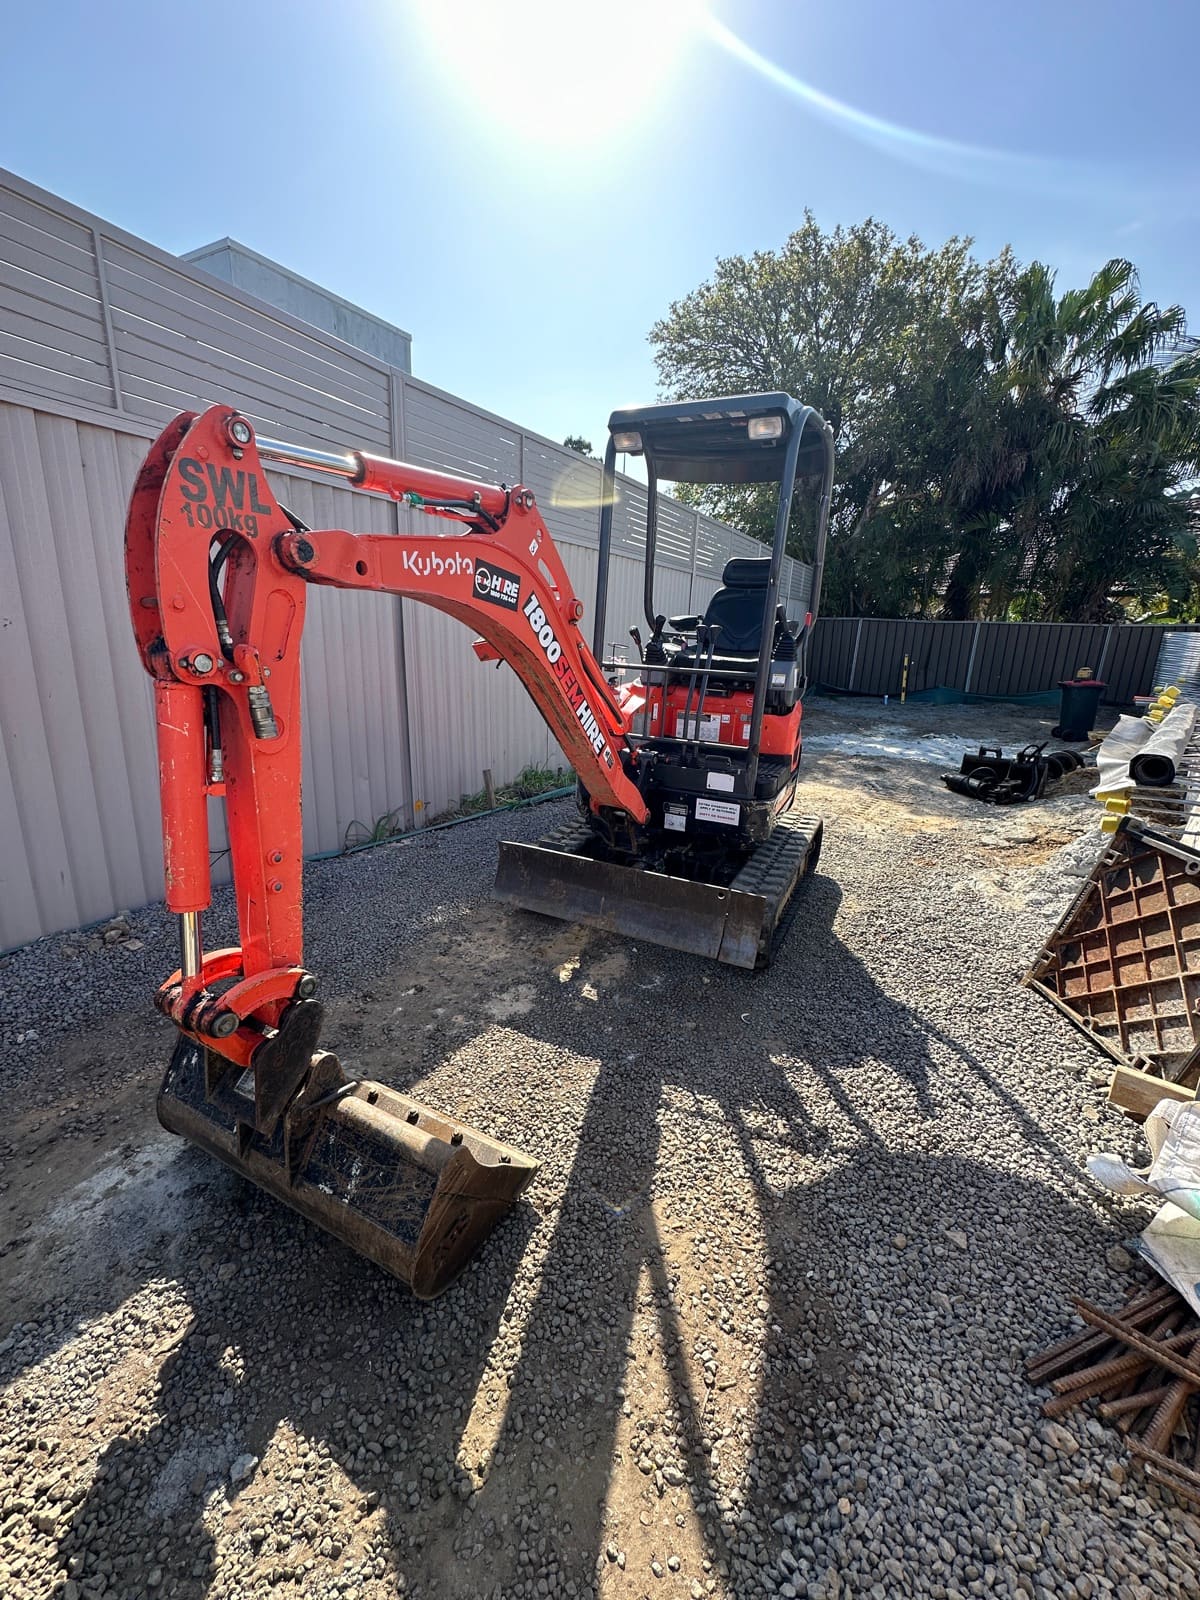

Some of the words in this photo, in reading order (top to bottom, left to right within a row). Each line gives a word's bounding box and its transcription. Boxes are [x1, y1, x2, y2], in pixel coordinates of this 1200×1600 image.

[178, 457, 272, 516] SWL
[181, 501, 259, 538] 100kg
[402, 550, 474, 576] Kubota
[491, 574, 520, 598] HIRE
